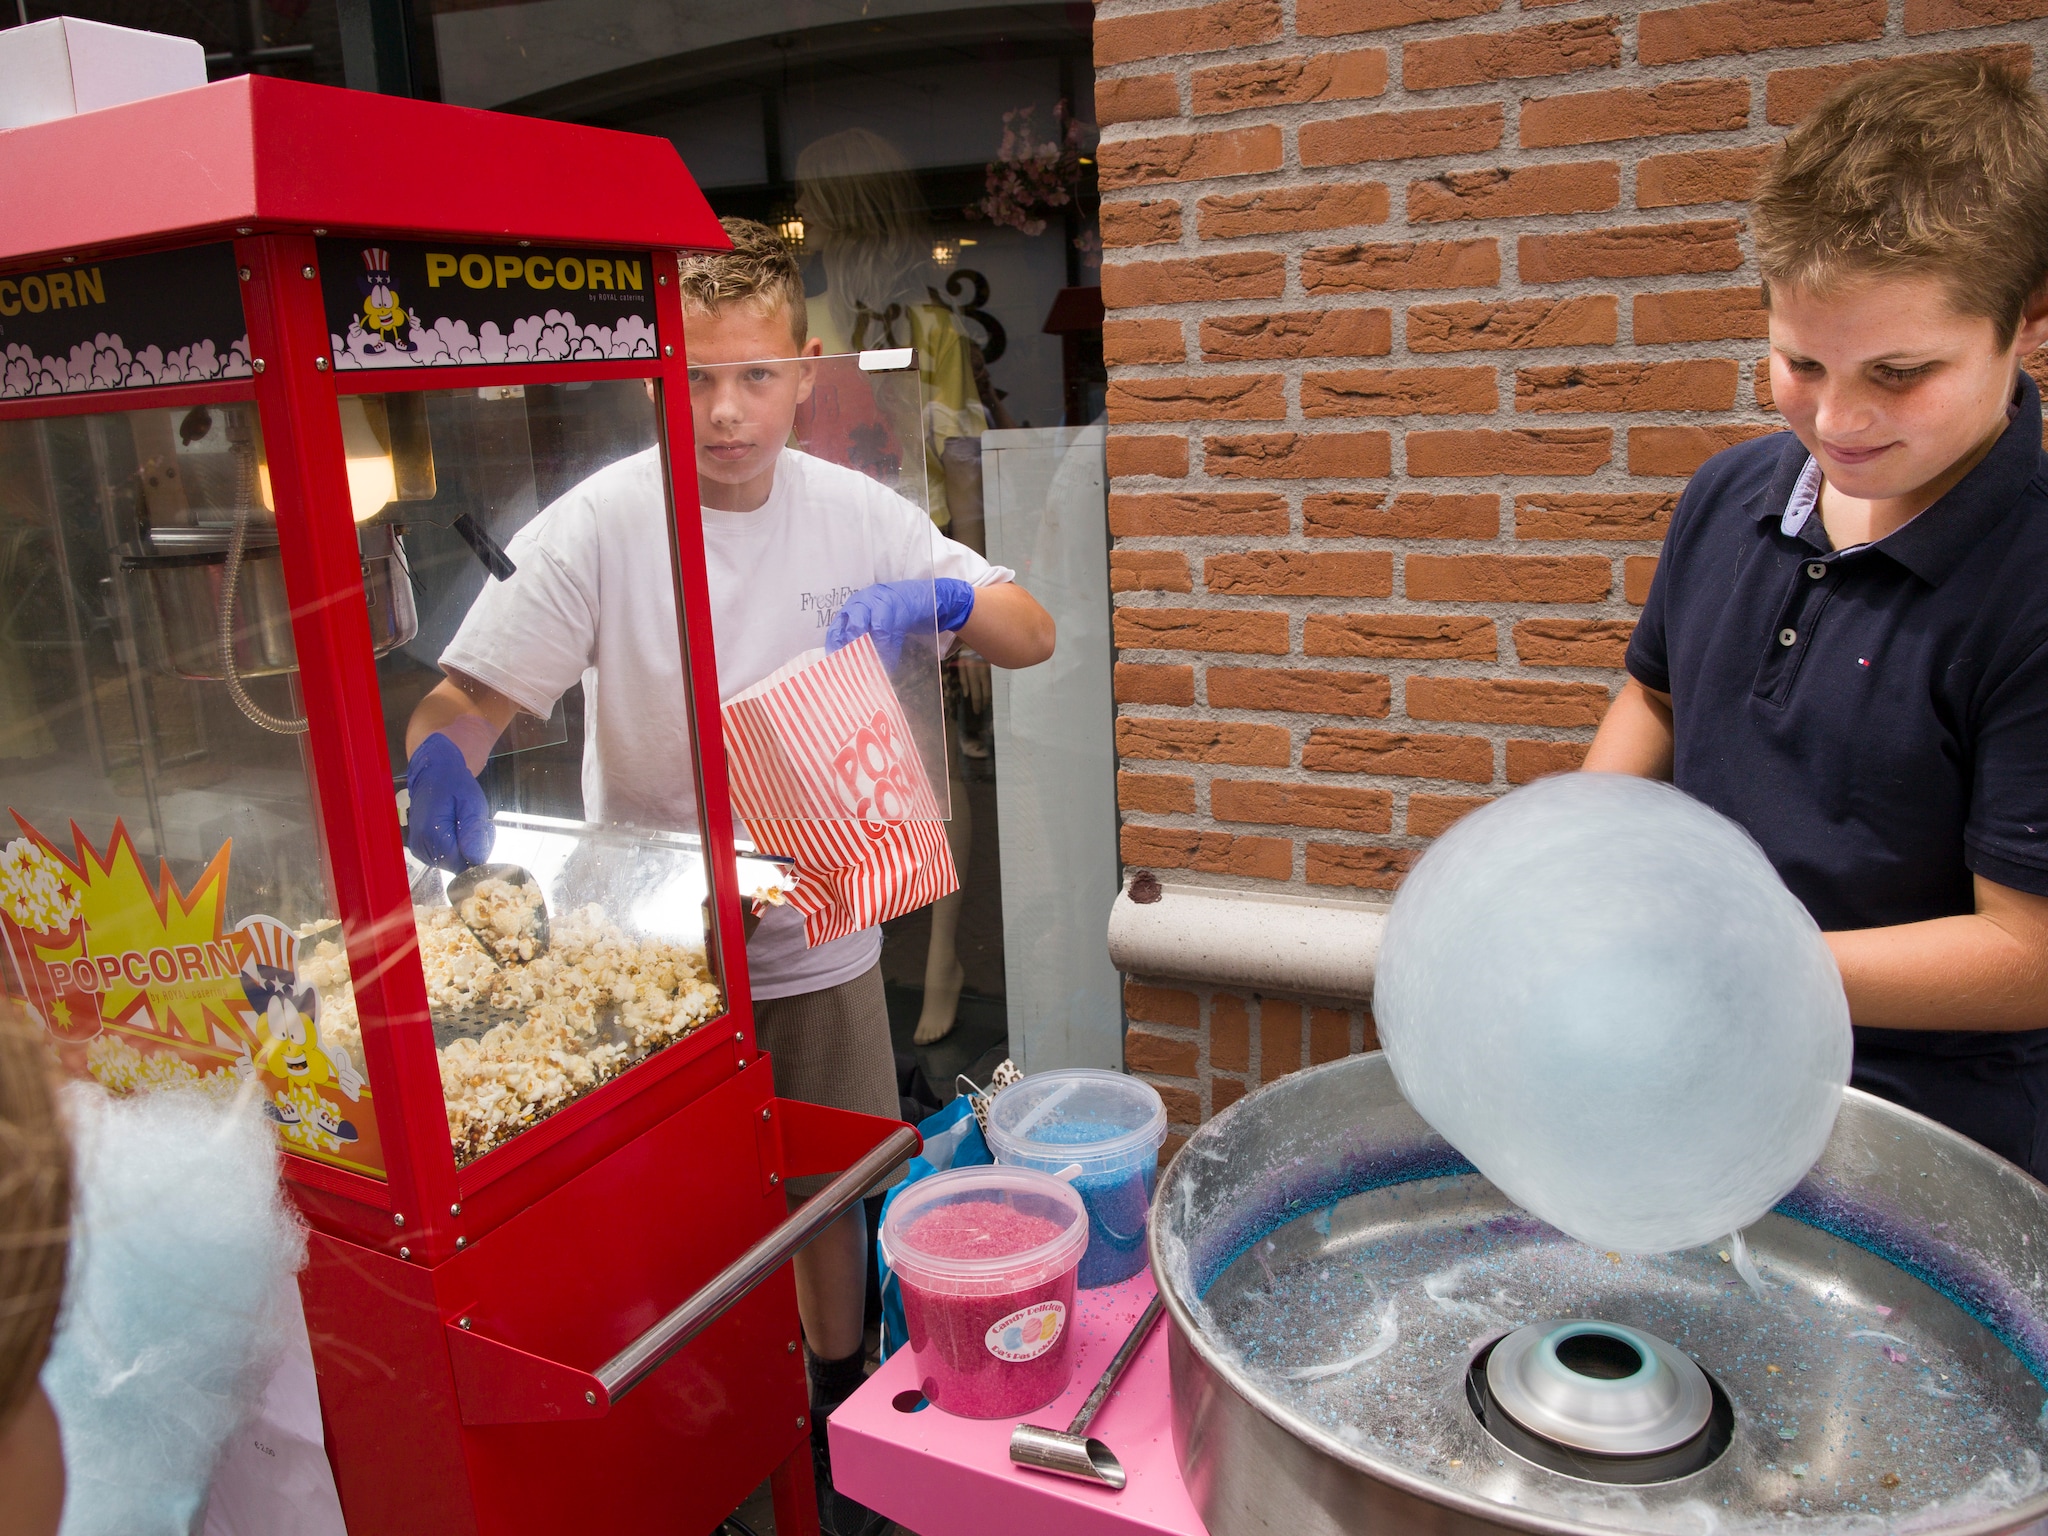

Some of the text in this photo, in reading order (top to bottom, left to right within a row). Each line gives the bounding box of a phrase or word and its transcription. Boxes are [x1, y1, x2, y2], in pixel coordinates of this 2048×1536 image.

[425, 253, 643, 291] POPCORN
[0, 268, 106, 316] CORN
[589, 293, 645, 303] by ROYAL catering
[833, 709, 898, 803] POP
[47, 939, 242, 997] POPCORN
[150, 987, 229, 1004] by ROYAL catering
[992, 1304, 1062, 1333] Candy Delicious
